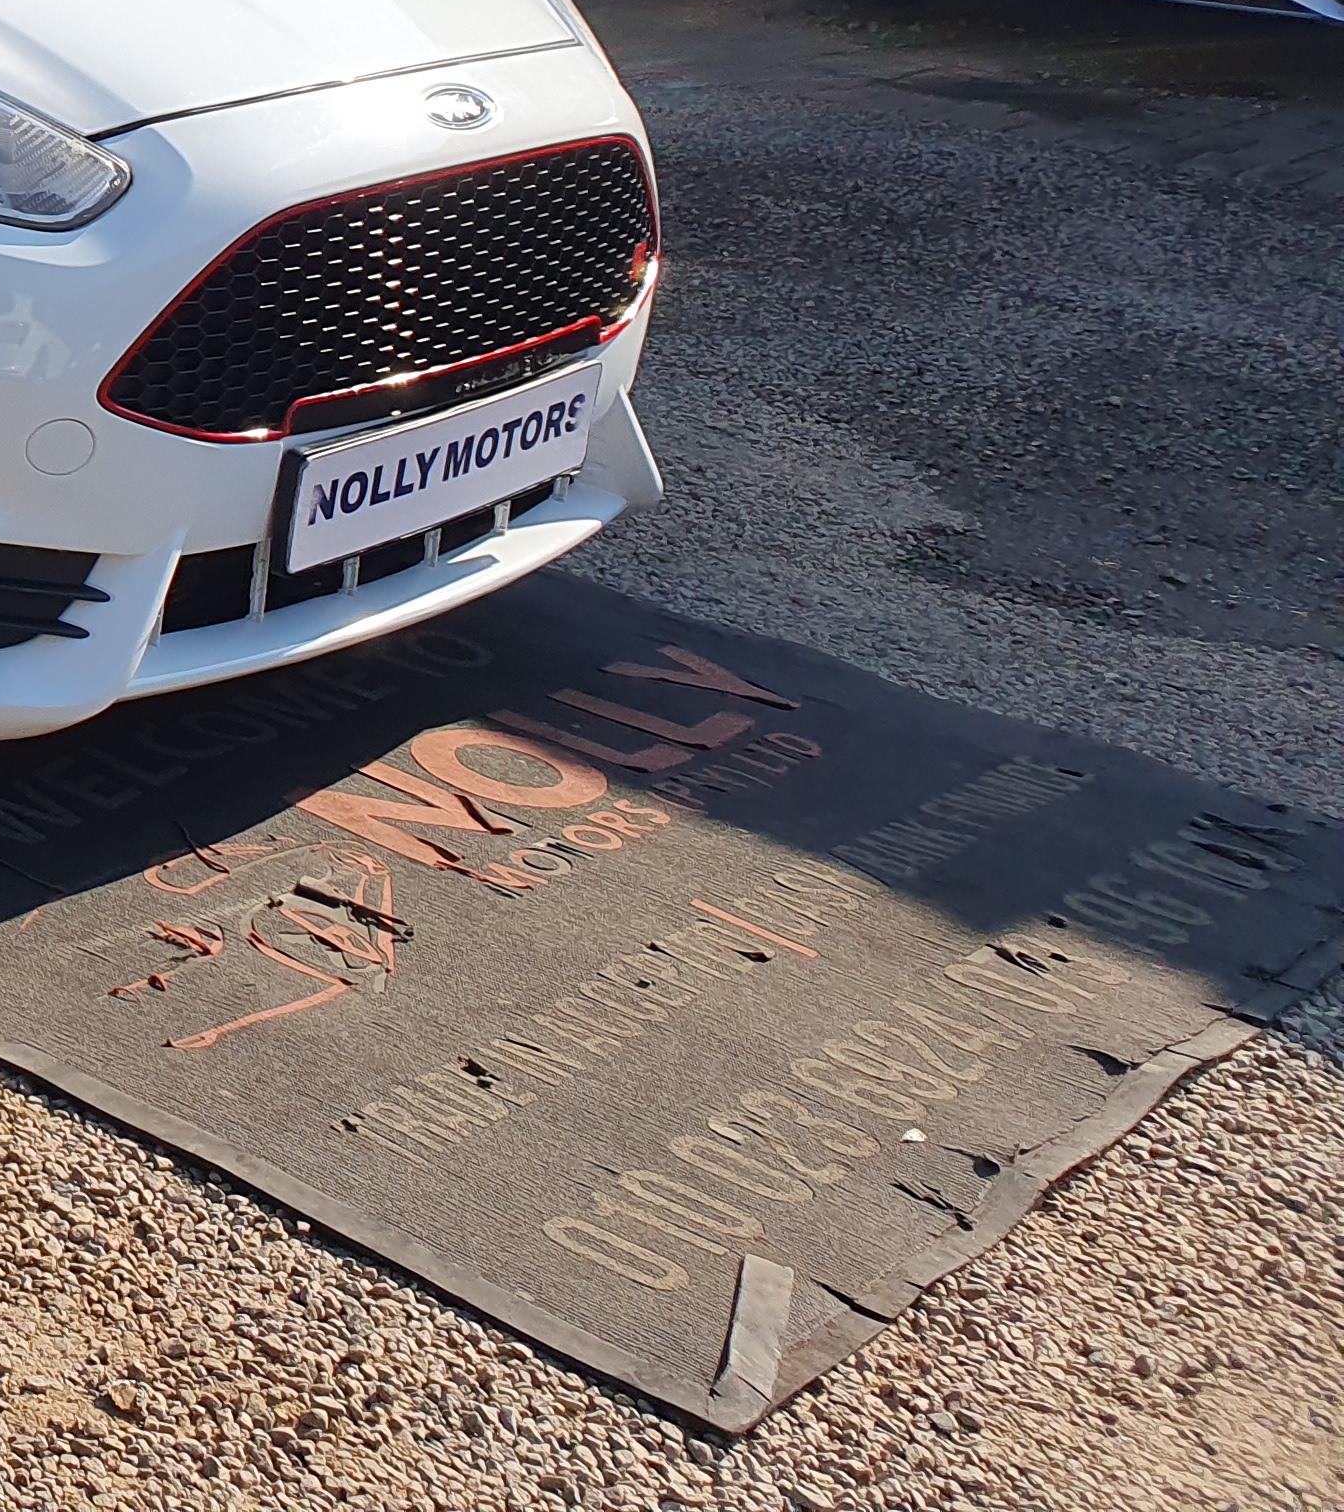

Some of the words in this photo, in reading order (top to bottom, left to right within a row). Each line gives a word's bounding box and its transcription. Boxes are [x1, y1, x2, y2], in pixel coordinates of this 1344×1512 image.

[308, 447, 439, 527] NOLLY
[442, 392, 587, 483] MOTORS
[367, 629, 493, 678] TO
[285, 644, 801, 868] NOLLY
[918, 755, 1096, 832] FINANCE
[472, 799, 672, 899] MOTORS
[531, 918, 776, 1059] ACCEPTED
[330, 1057, 539, 1166] TRADE
[477, 1031, 586, 1087] IN
[542, 1169, 765, 1291] 010
[669, 1091, 881, 1202] 023
